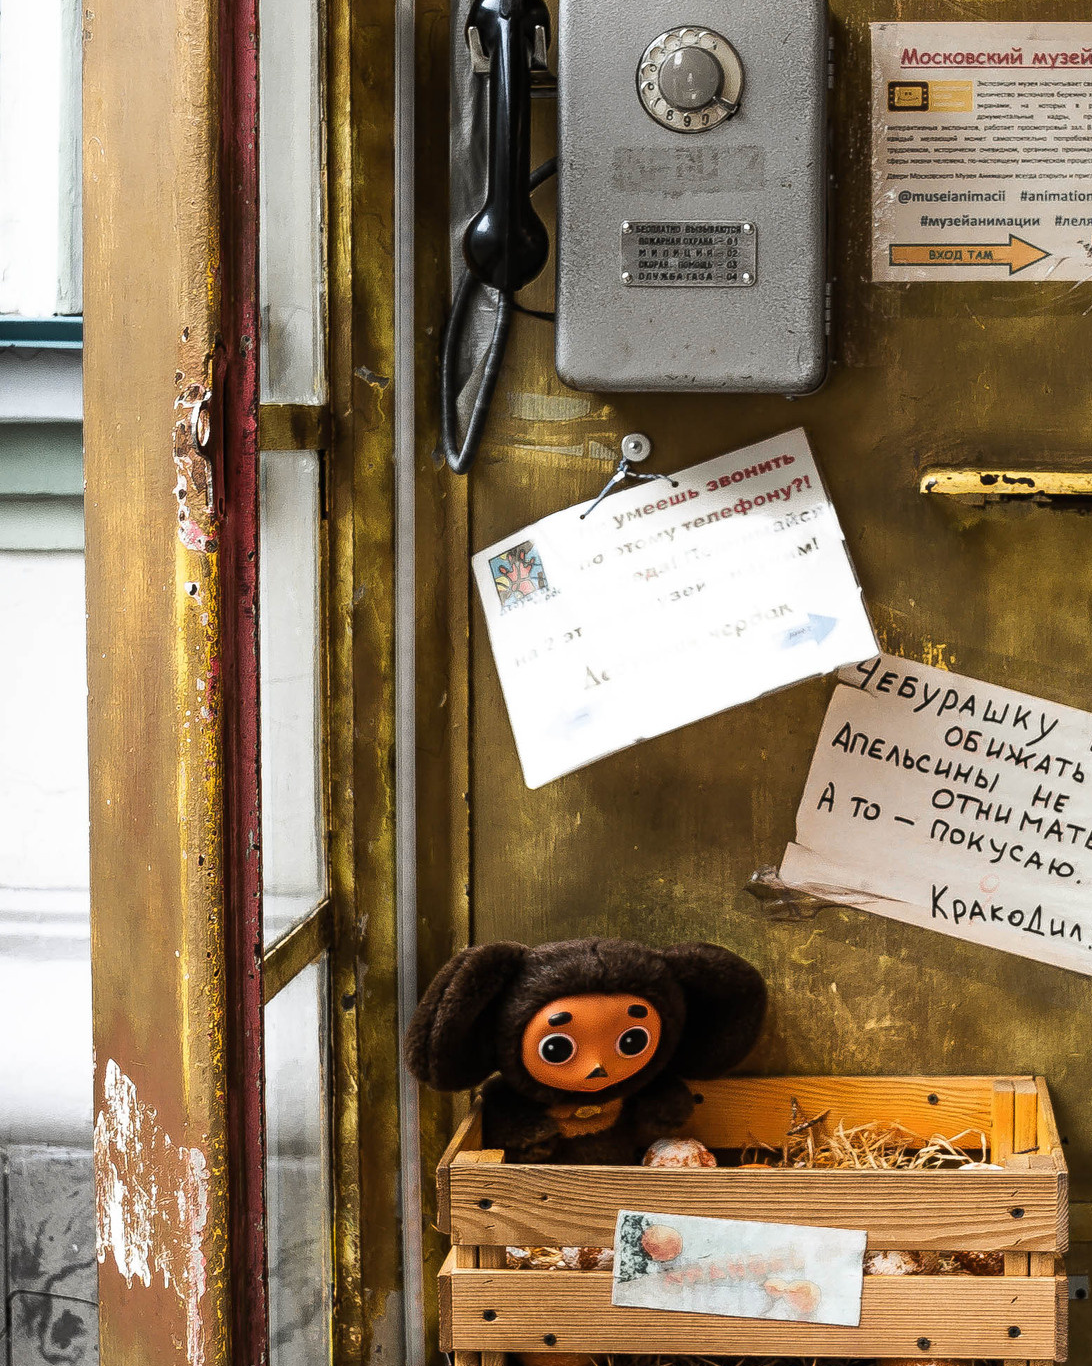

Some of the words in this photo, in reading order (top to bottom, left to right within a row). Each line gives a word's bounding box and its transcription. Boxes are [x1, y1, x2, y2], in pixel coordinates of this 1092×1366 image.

[900, 47, 1023, 67] Московский
[898, 190, 1006, 204] @museianimacii
[920, 214, 1041, 229] #музейанимации
[928, 249, 963, 263] ВХОД
[968, 249, 995, 262] ТАМ
[612, 487, 699, 529] умеешь
[706, 452, 796, 493] звонить
[681, 475, 812, 532] телефону?!
[855, 657, 1060, 747] ЧЕБУРАШКУ
[831, 721, 1001, 794] АПЕЛЬСИНЫ
[1031, 783, 1071, 814] НЕ
[944, 724, 1086, 784] ОБИЖАТЬ
[817, 780, 836, 813] А
[929, 819, 1082, 885] ПОКУСАЮ.
